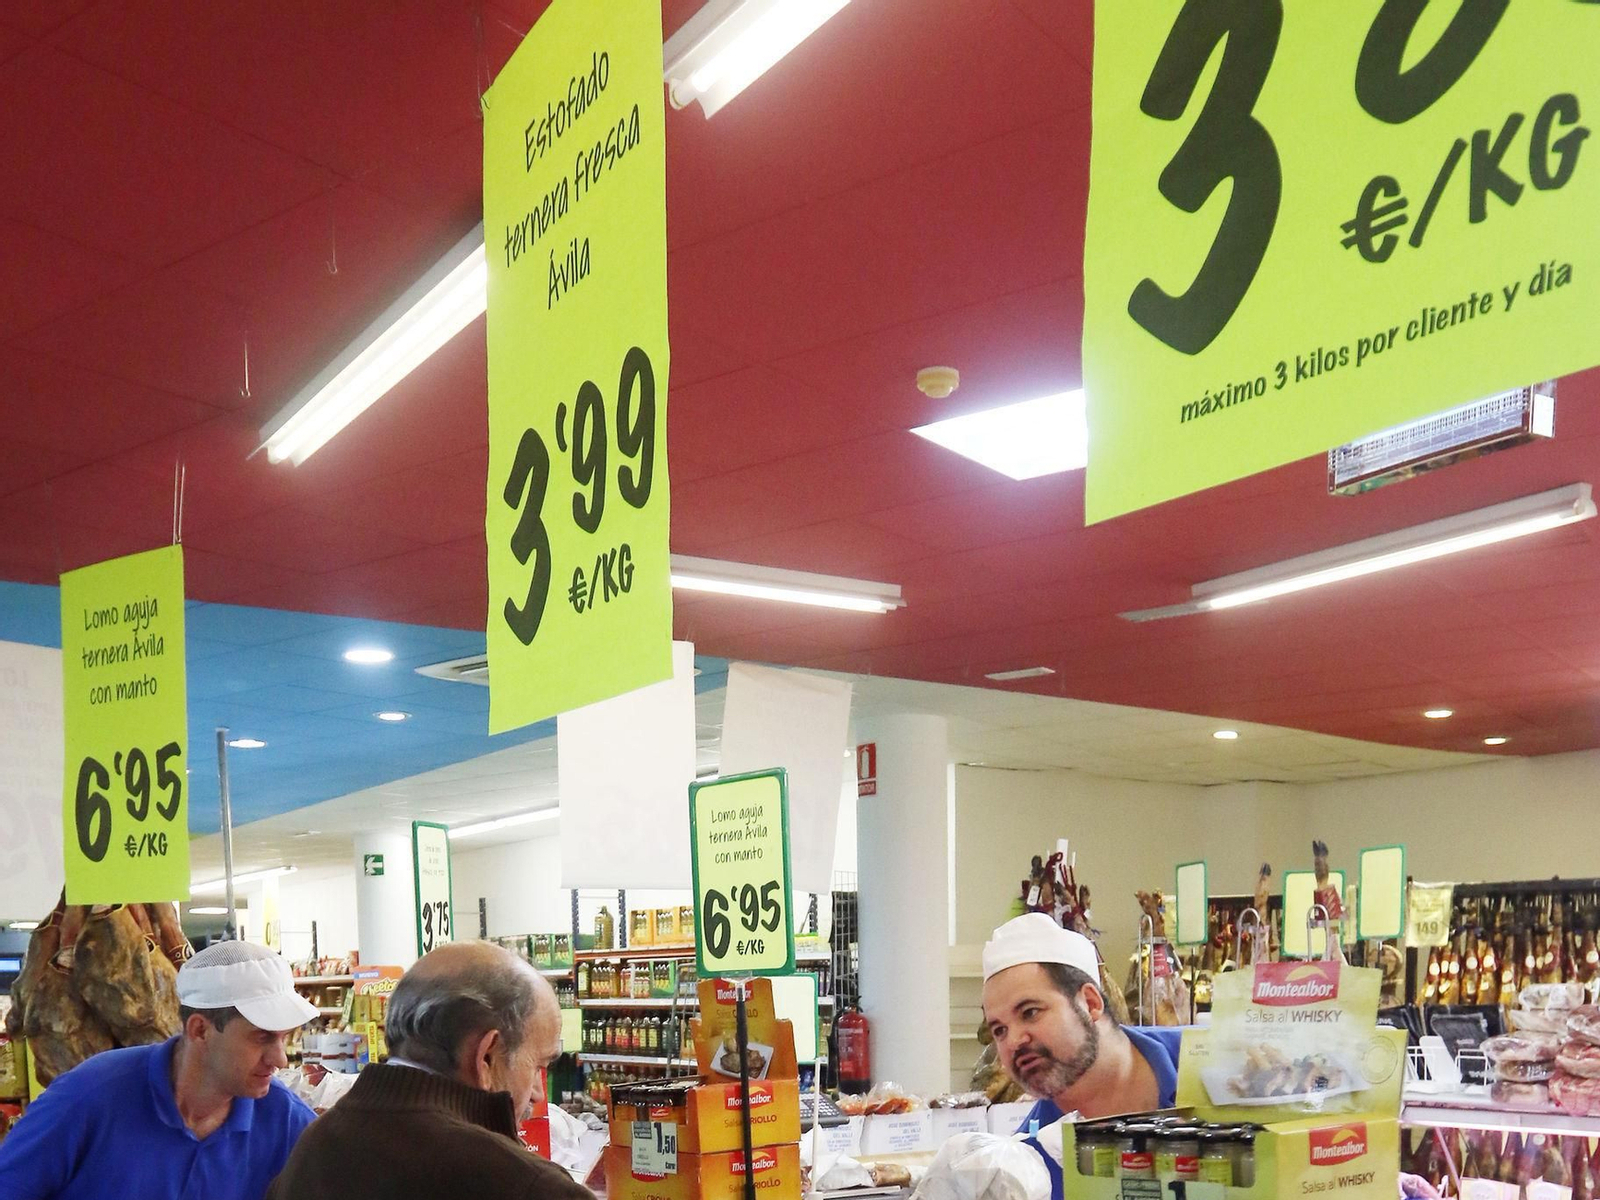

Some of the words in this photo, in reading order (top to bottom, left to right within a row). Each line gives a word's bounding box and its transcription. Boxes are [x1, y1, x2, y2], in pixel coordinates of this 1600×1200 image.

[525, 52, 609, 173] Estofado
[505, 176, 569, 268] ternera
[574, 104, 640, 202] fresca
[1340, 93, 1590, 263] €/KG
[548, 237, 591, 310] Ávila
[1180, 374, 1267, 423] máximo
[1274, 361, 1289, 390] 3
[1295, 345, 1350, 383] kilos
[1356, 324, 1400, 366] por
[1406, 291, 1494, 342] cliente
[1503, 282, 1521, 312] y
[1528, 260, 1572, 297] día
[503, 346, 656, 646] 3'99
[568, 543, 634, 614] €/KG
[84, 606, 119, 632] Lomo
[123, 597, 159, 636] aguja
[81, 646, 129, 670] ternera
[132, 631, 165, 662] Ávila
[89, 683, 113, 706] con
[115, 675, 158, 702] manto
[75, 741, 182, 863] 6'95
[711, 808, 737, 824] Lomo
[739, 804, 764, 824] aguja
[124, 832, 168, 858] €/KG
[708, 830, 743, 845] ternera
[714, 851, 732, 864] con
[734, 847, 764, 862] manto
[703, 880, 781, 959] 6'95
[736, 939, 765, 956] €/KG
[1256, 981, 1334, 998] Montealbor
[1245, 1009, 1275, 1023] Salsa
[1277, 1009, 1290, 1023] al
[1291, 1009, 1343, 1023] WHISKY
[653, 1121, 676, 1155] 1,50
[1313, 1141, 1365, 1160] Montealbor
[1302, 1181, 1325, 1195] Salsa
[1338, 1171, 1376, 1188] WHISKY
